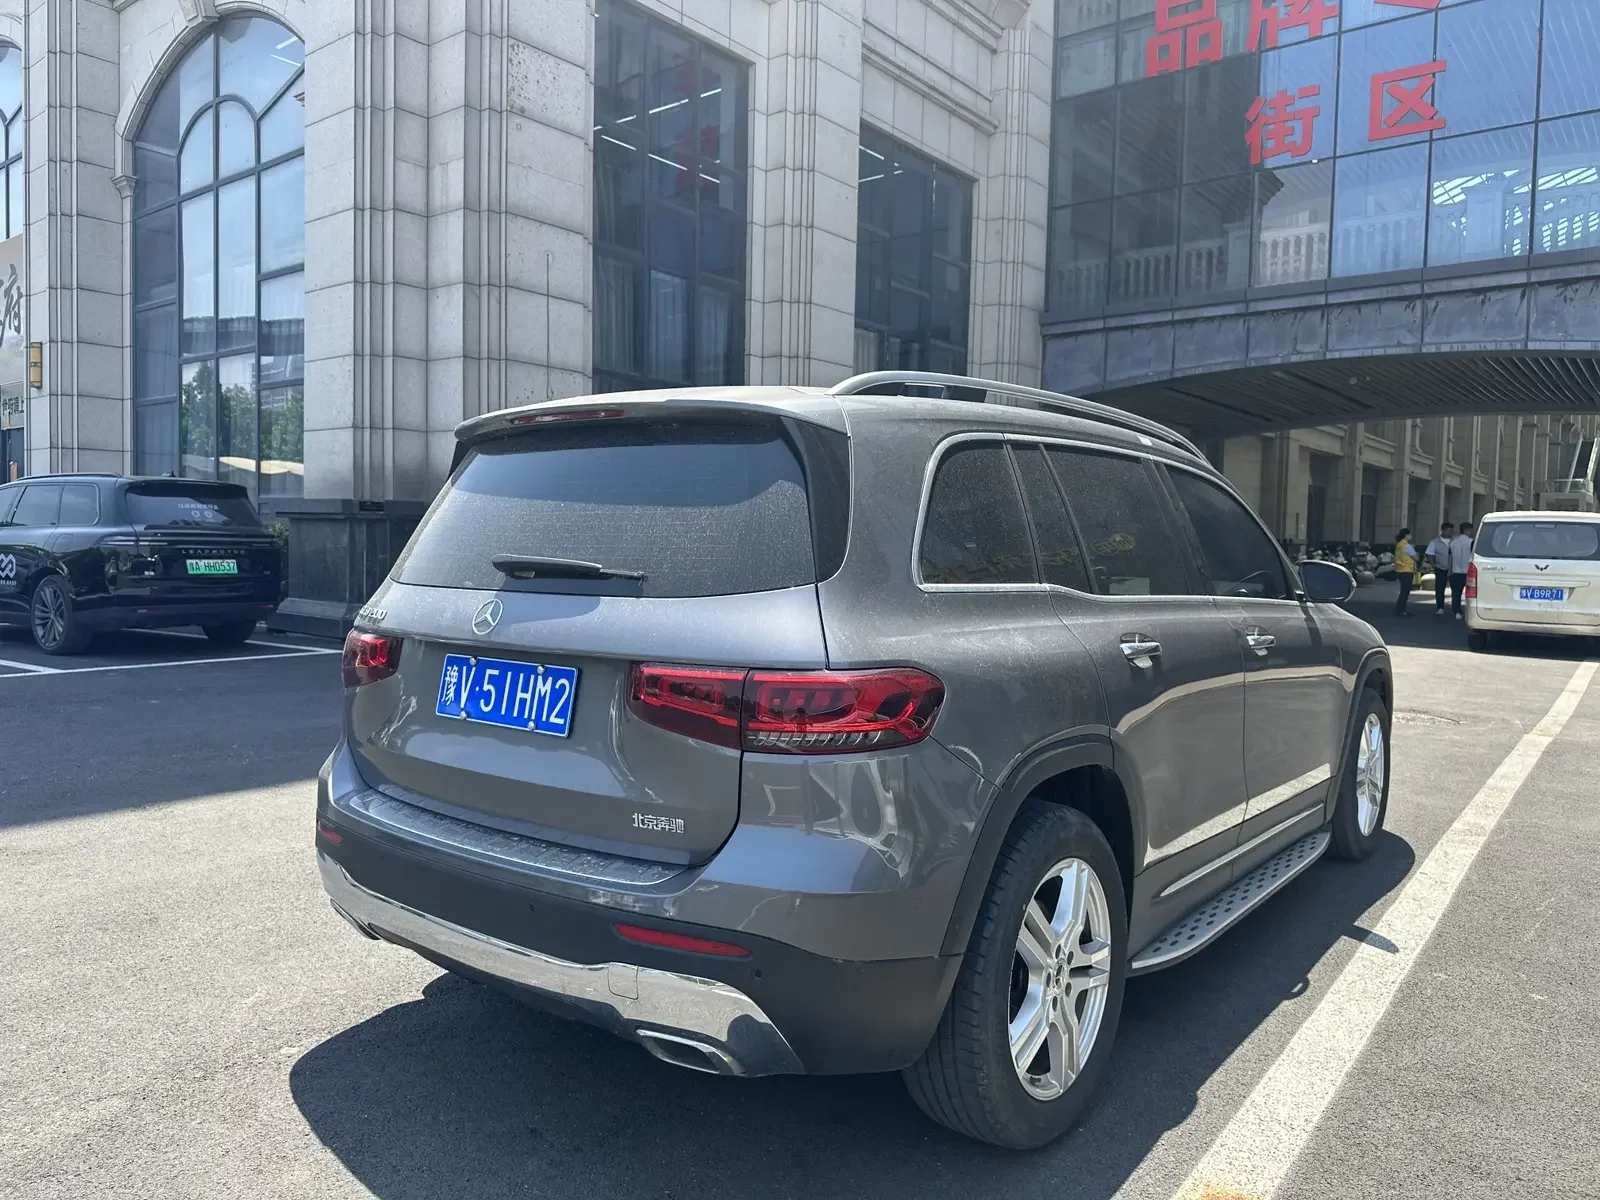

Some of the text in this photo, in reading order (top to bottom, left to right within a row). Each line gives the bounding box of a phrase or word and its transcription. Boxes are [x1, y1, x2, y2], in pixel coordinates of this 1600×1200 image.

[1245, 60, 1446, 165] 街区
[632, 812, 684, 834] 北京奔驰
